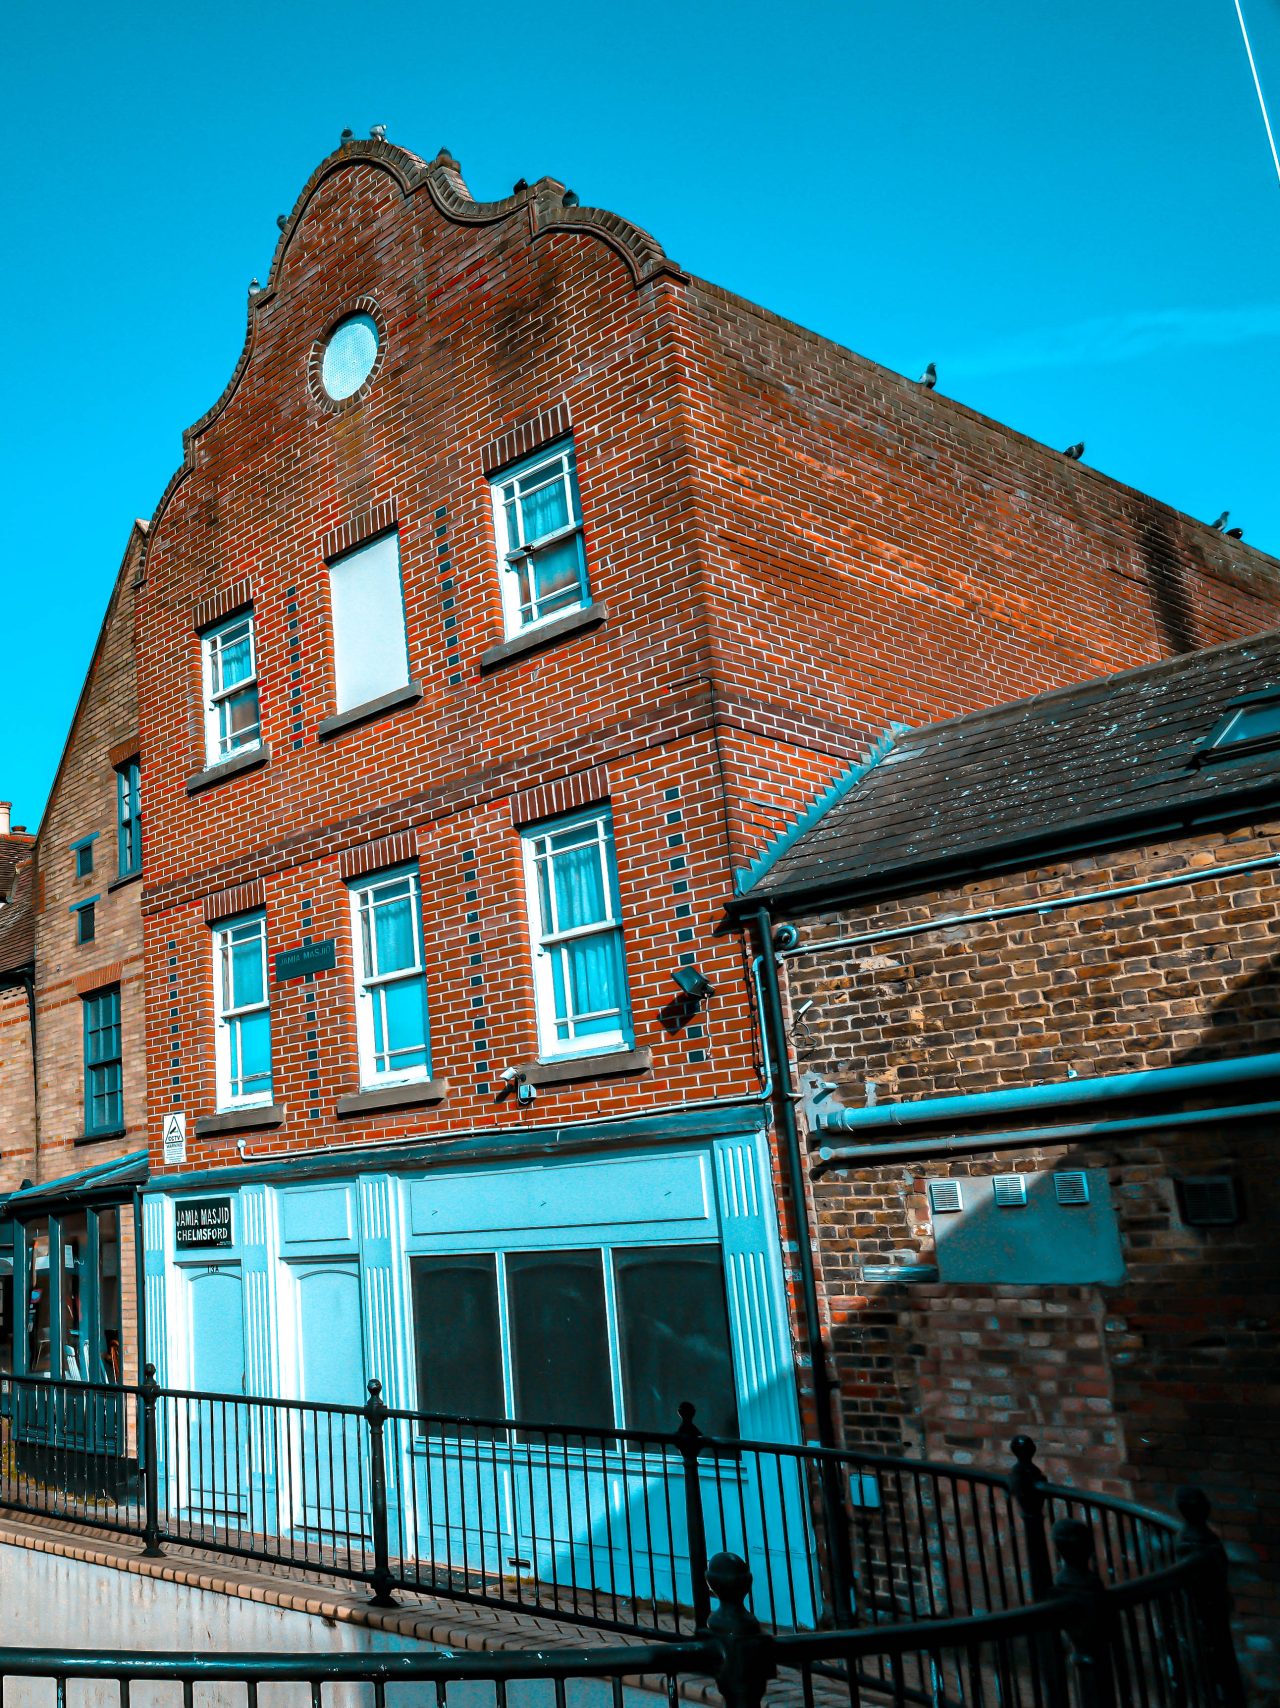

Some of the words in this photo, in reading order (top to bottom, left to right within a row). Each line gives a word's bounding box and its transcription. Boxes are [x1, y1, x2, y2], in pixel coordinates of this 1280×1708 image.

[176, 1209, 199, 1226] JAMIA
[200, 1207, 229, 1225] MASJID
[177, 1227, 228, 1241] CHELMSFORD
